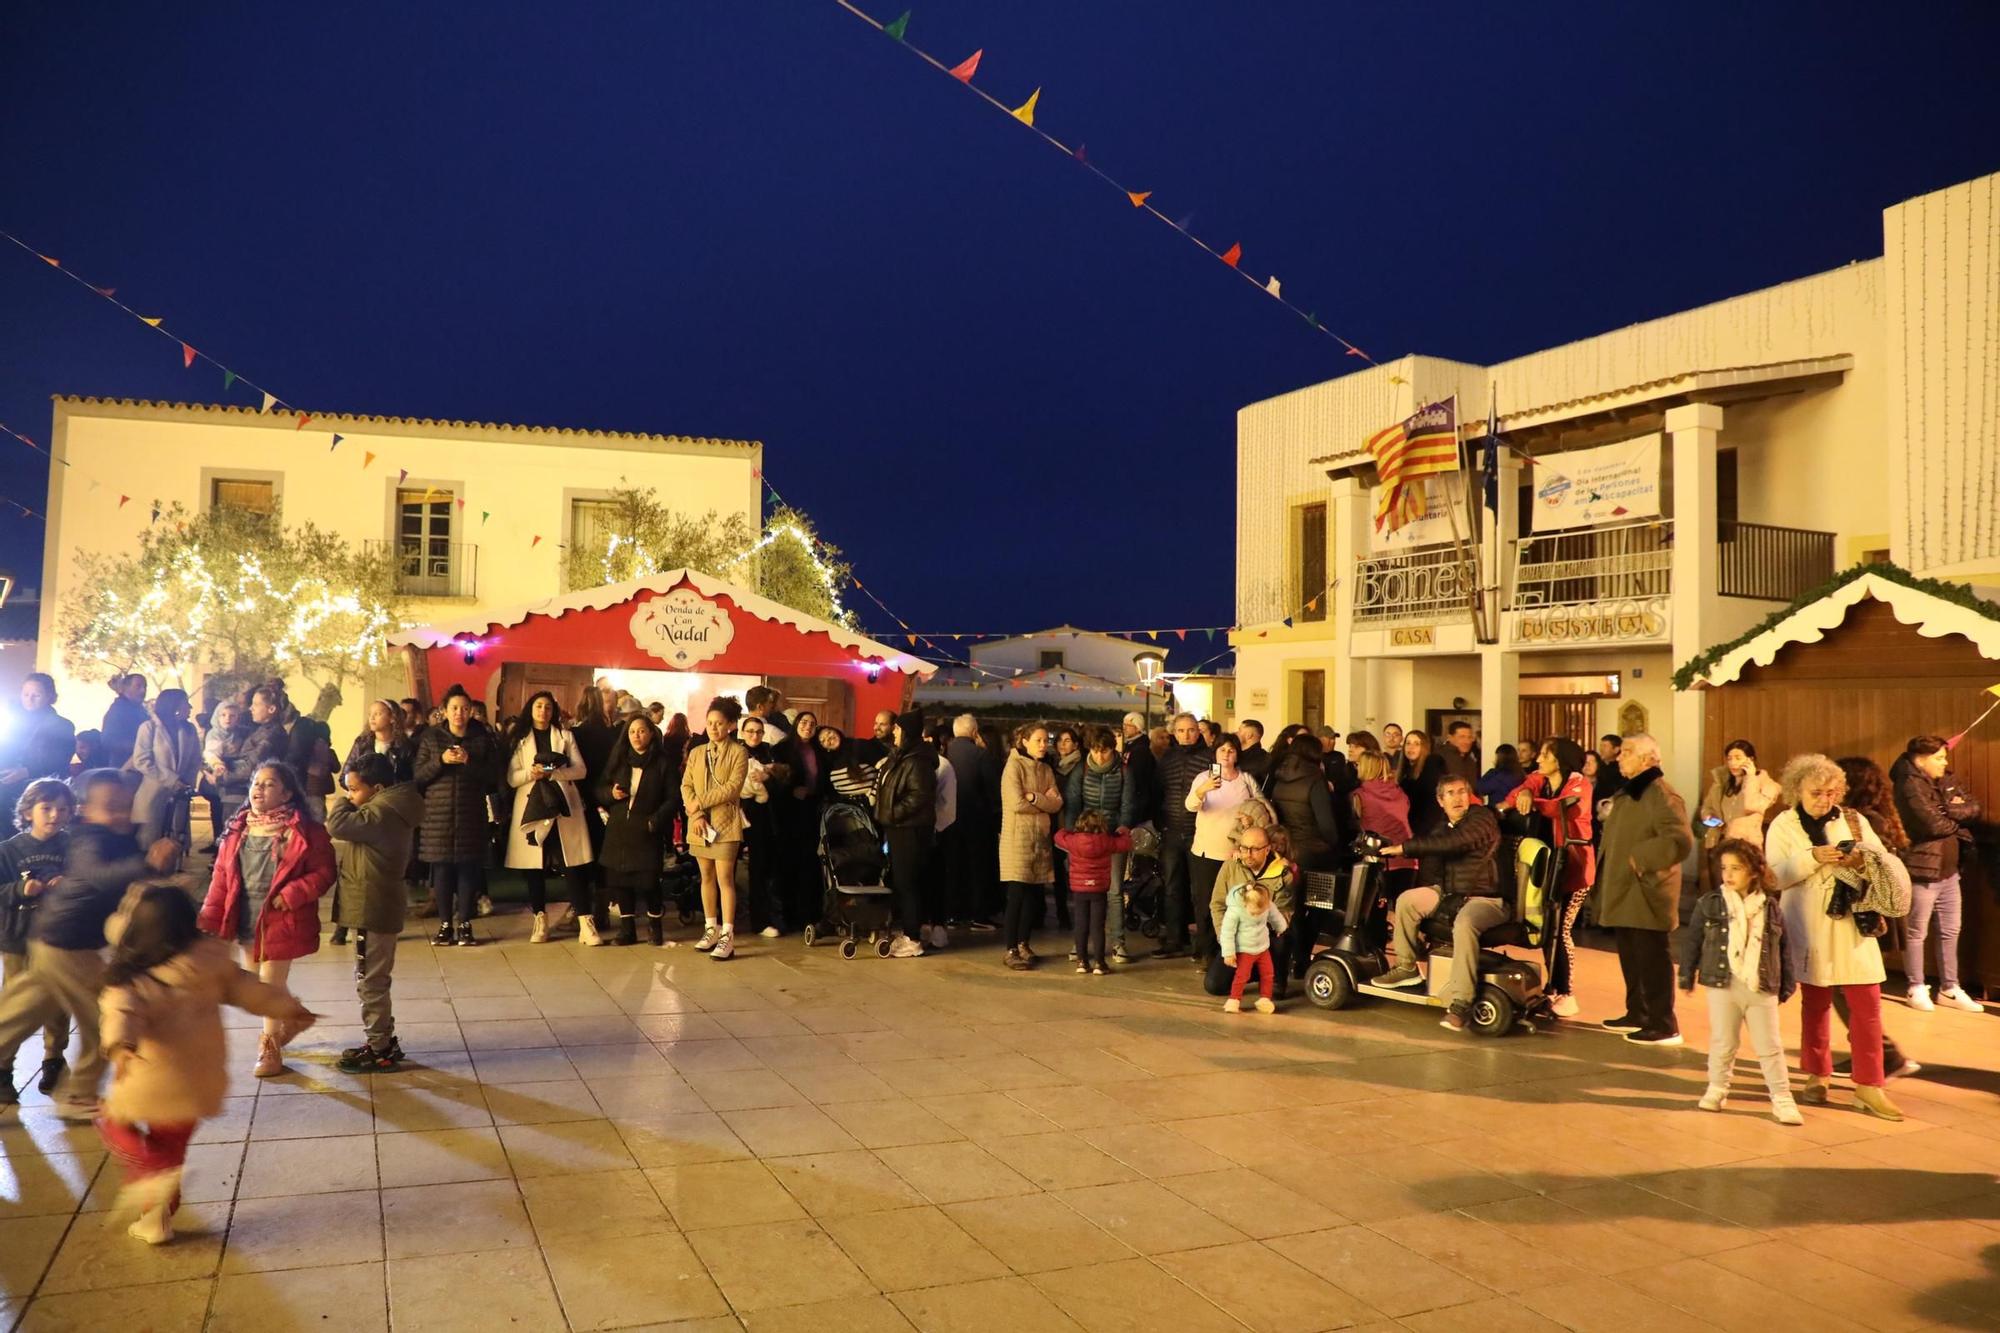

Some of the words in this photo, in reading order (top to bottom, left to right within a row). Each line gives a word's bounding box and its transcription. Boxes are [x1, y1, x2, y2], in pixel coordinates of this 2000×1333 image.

[1600, 478, 1640, 491] Persones
[664, 604, 693, 615] Venda
[695, 606, 705, 615] de
[1511, 590, 1667, 643] Festes
[673, 615, 693, 625] Can
[655, 623, 710, 645] Nadal
[1394, 629, 1433, 645] CASA
